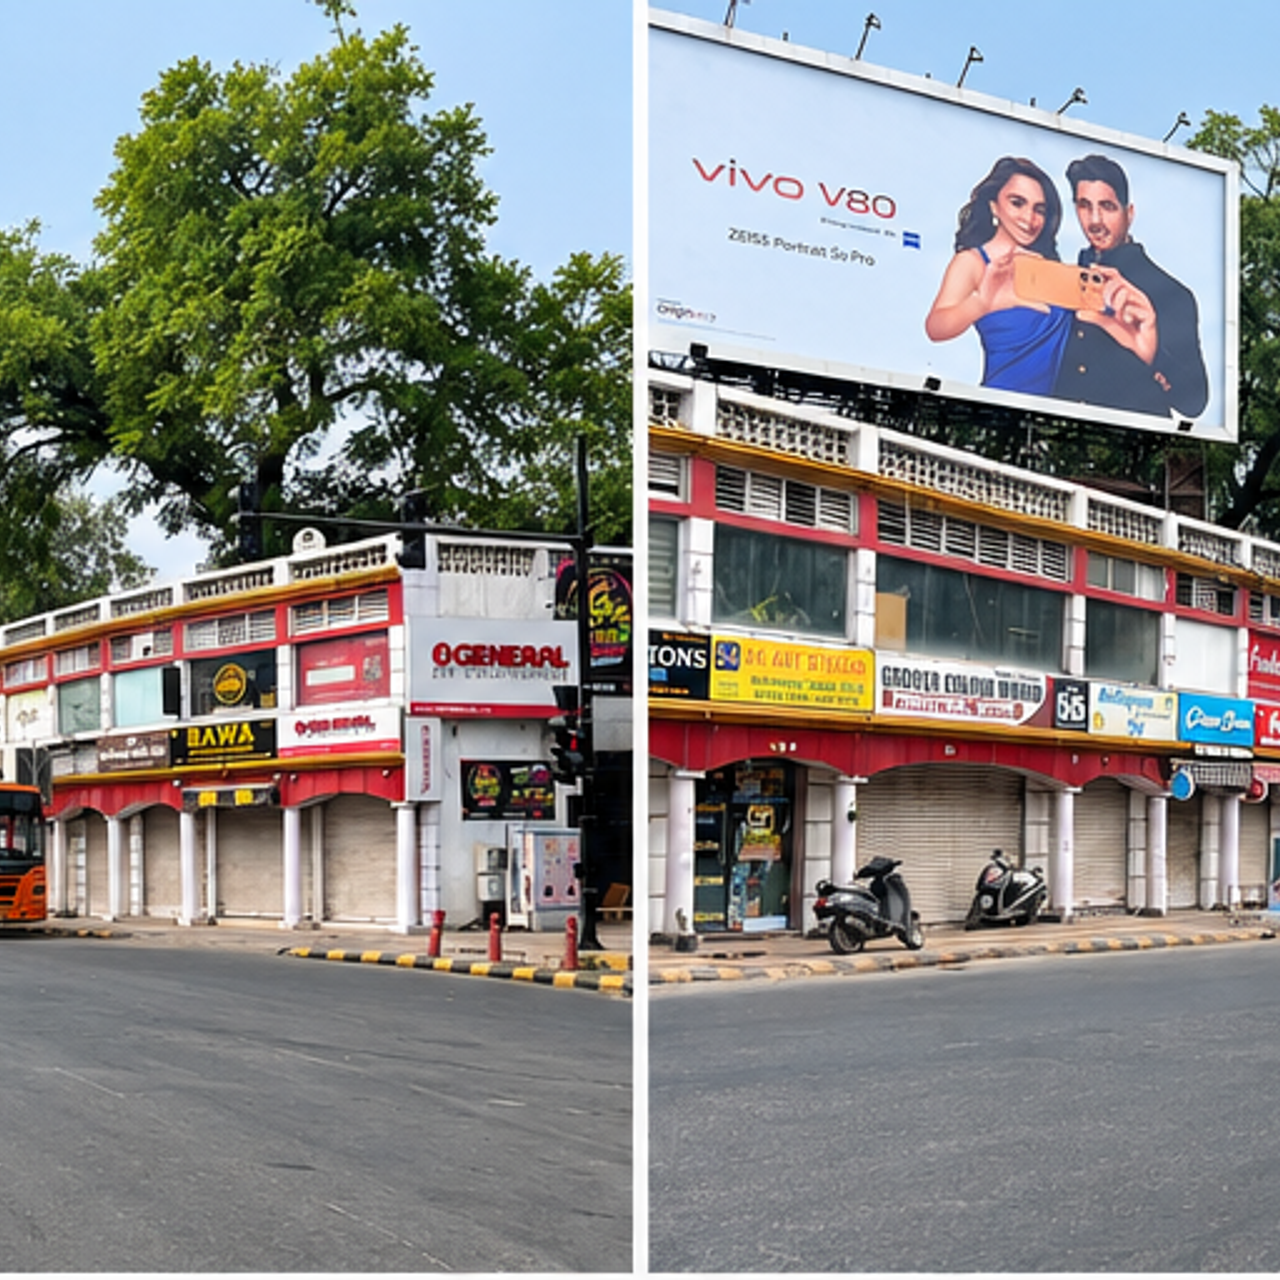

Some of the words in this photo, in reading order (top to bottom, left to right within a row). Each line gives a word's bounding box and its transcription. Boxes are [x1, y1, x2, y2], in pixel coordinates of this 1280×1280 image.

[692, 158, 805, 200] vivo
[818, 182, 896, 219] V80
[850, 249, 876, 267] Pro
